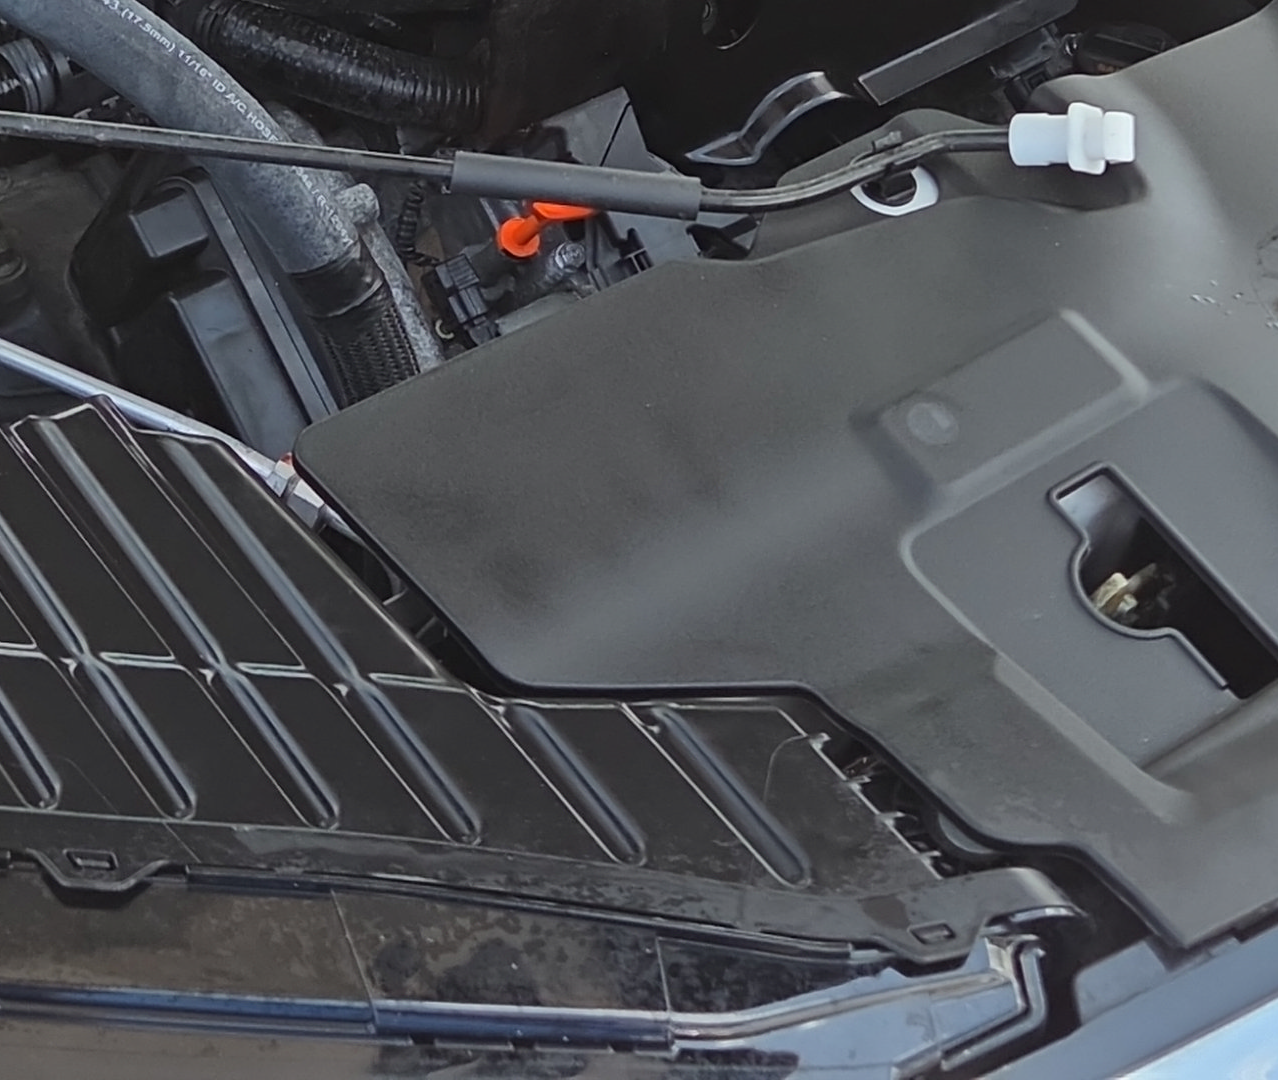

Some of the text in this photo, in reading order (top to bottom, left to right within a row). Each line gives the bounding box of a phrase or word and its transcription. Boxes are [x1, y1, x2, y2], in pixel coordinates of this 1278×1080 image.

[120, 8, 176, 52] (17.5mm)
[212, 78, 227, 93] ID
[226, 92, 248, 114] A/C
